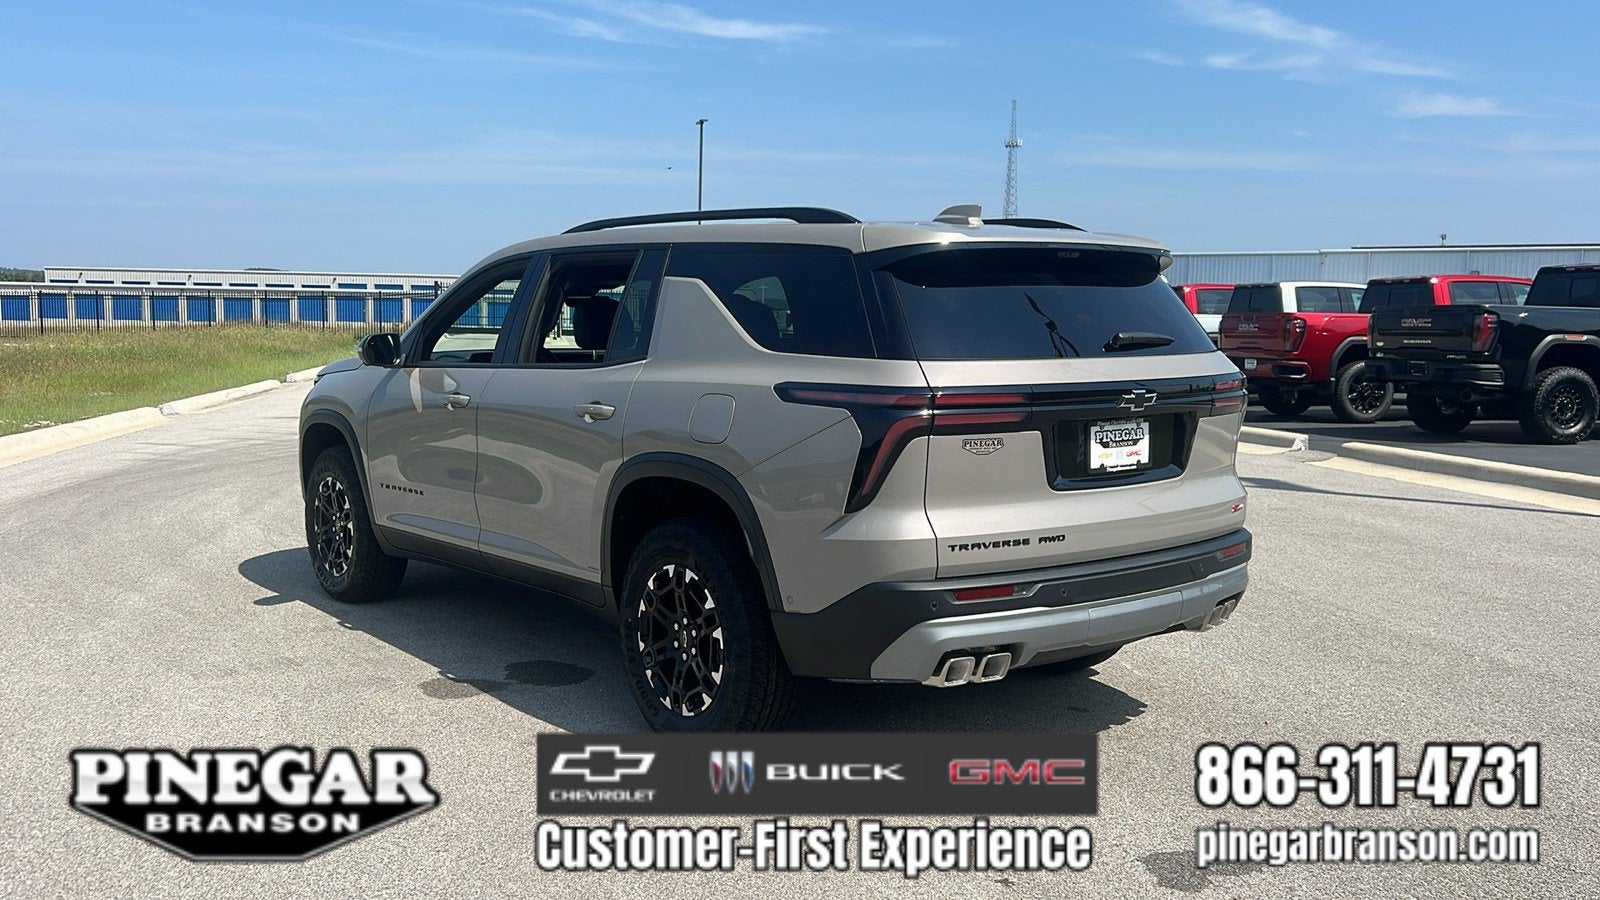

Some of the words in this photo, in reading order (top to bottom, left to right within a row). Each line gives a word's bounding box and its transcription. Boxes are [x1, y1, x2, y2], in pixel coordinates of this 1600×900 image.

[1095, 428, 1144, 443] PINEGAR
[964, 439, 1002, 448] PINEGAR
[379, 482, 425, 497] TRAVERSE
[948, 538, 1031, 552] TRAVERSE
[1038, 534, 1066, 545] AWD
